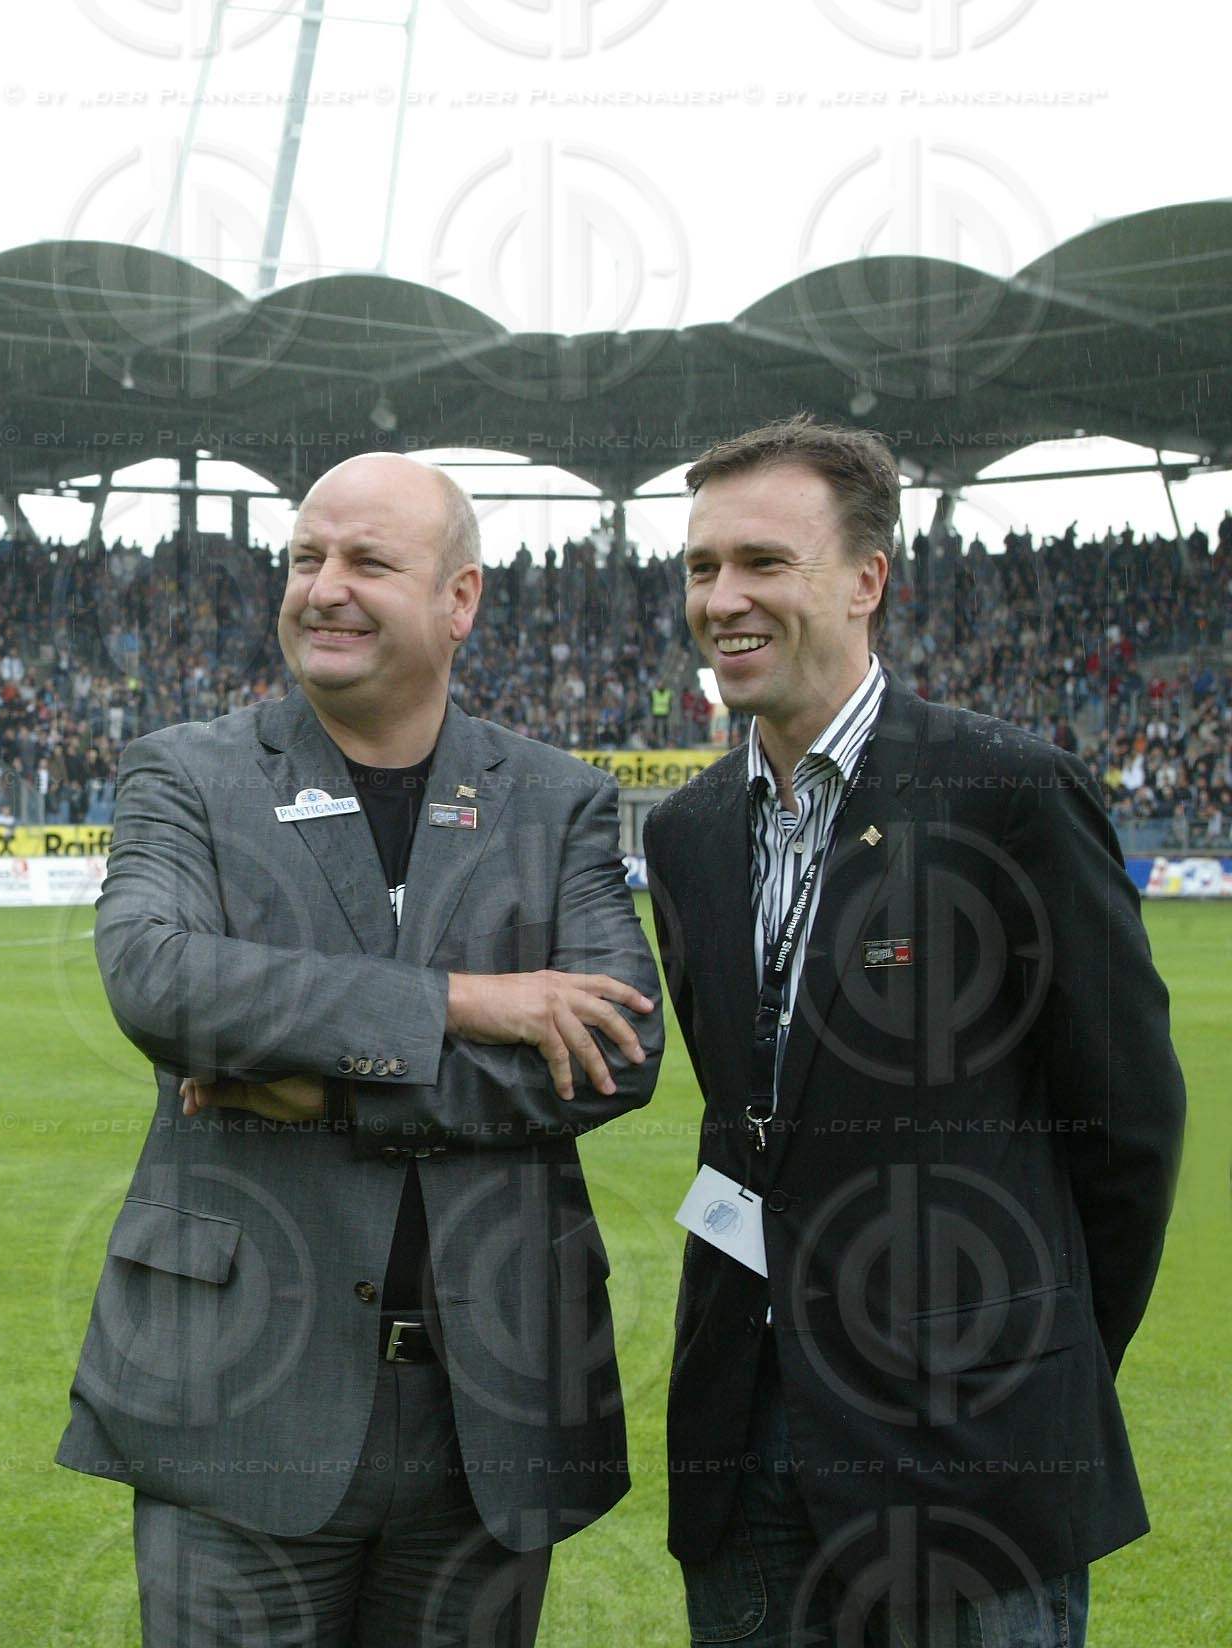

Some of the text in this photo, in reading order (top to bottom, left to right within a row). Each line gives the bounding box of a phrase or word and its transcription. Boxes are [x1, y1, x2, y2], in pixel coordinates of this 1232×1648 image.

[279, 800, 355, 819] PUNTIGAMER
[774, 864, 817, 972] SK Puntigamer Sturm
